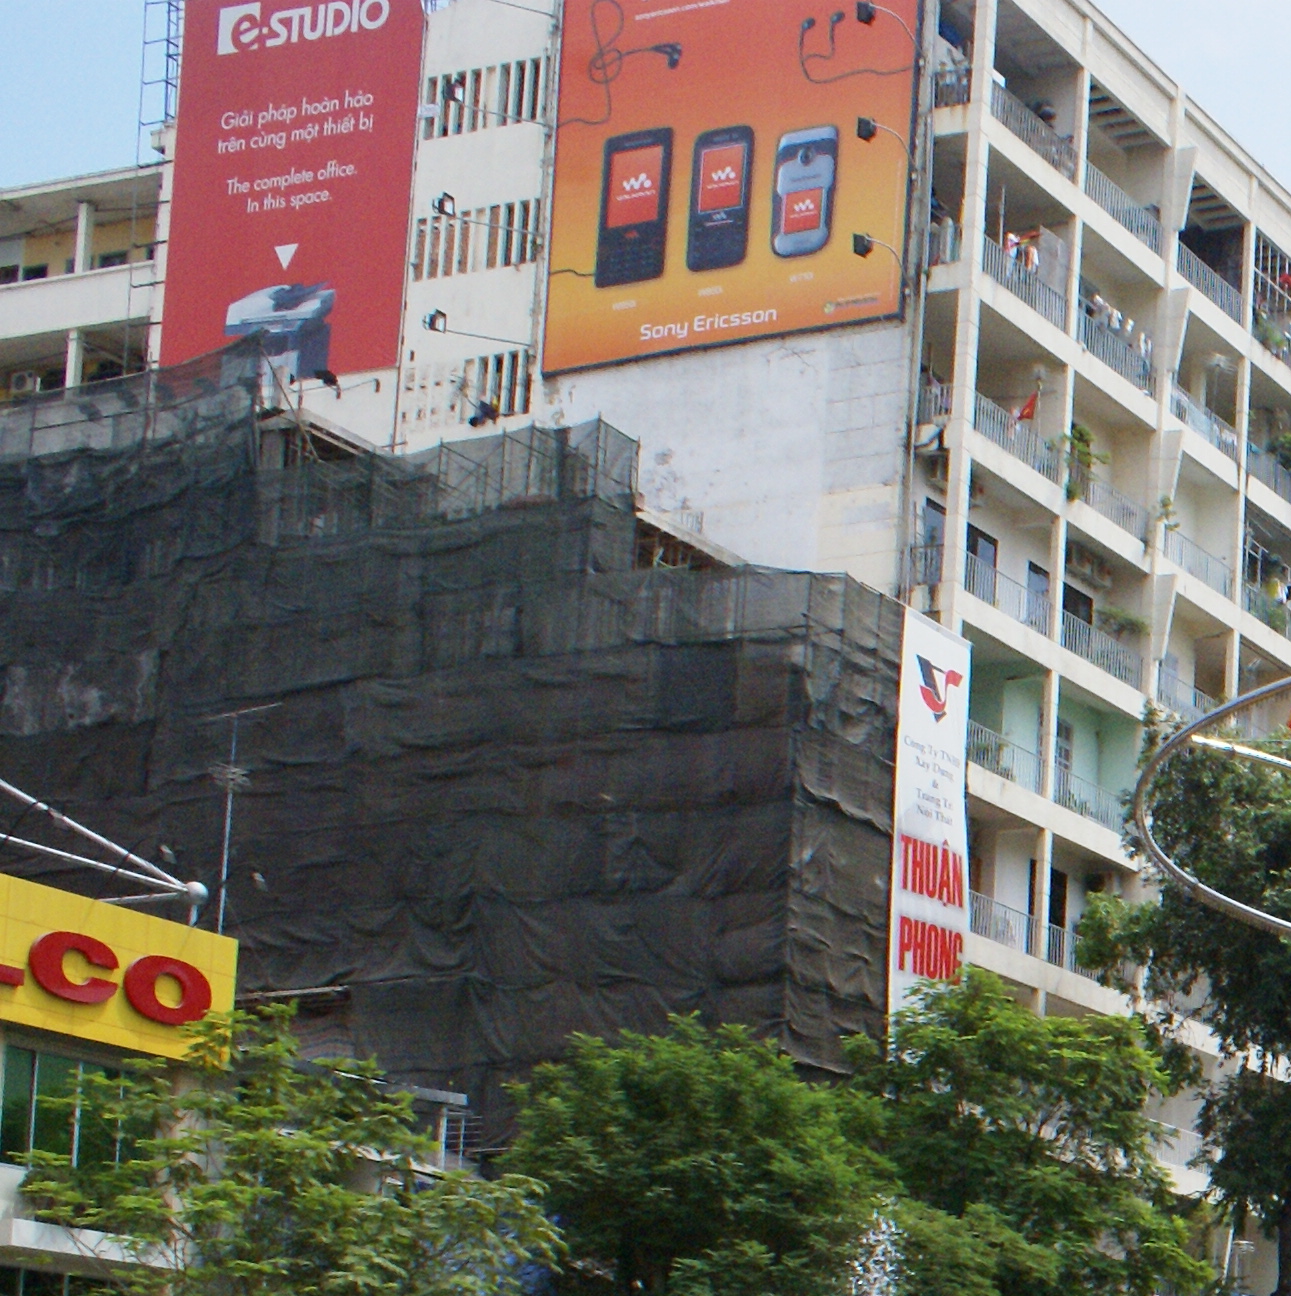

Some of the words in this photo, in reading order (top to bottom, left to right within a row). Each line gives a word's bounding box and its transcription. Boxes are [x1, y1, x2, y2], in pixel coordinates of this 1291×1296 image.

[217, 0, 391, 56] e-STUDIO
[220, 110, 254, 130] Giải
[257, 103, 297, 129] pháp
[301, 97, 340, 116] hoàn
[344, 90, 374, 109] hảo
[218, 137, 246, 154] trên
[250, 132, 287, 150] cùng
[291, 123, 319, 143] một
[323, 113, 356, 137] thiết
[359, 111, 374, 133] bị
[227, 177, 250, 195] The
[254, 167, 314, 190] complete
[317, 160, 358, 181] office.
[247, 198, 259, 213] In
[263, 193, 286, 211] this
[290, 190, 333, 210] space.
[640, 322, 689, 342] Sony
[694, 308, 778, 333] Ericsson
[901, 834, 963, 908] THUẬN
[0, 931, 212, 1026] CO
